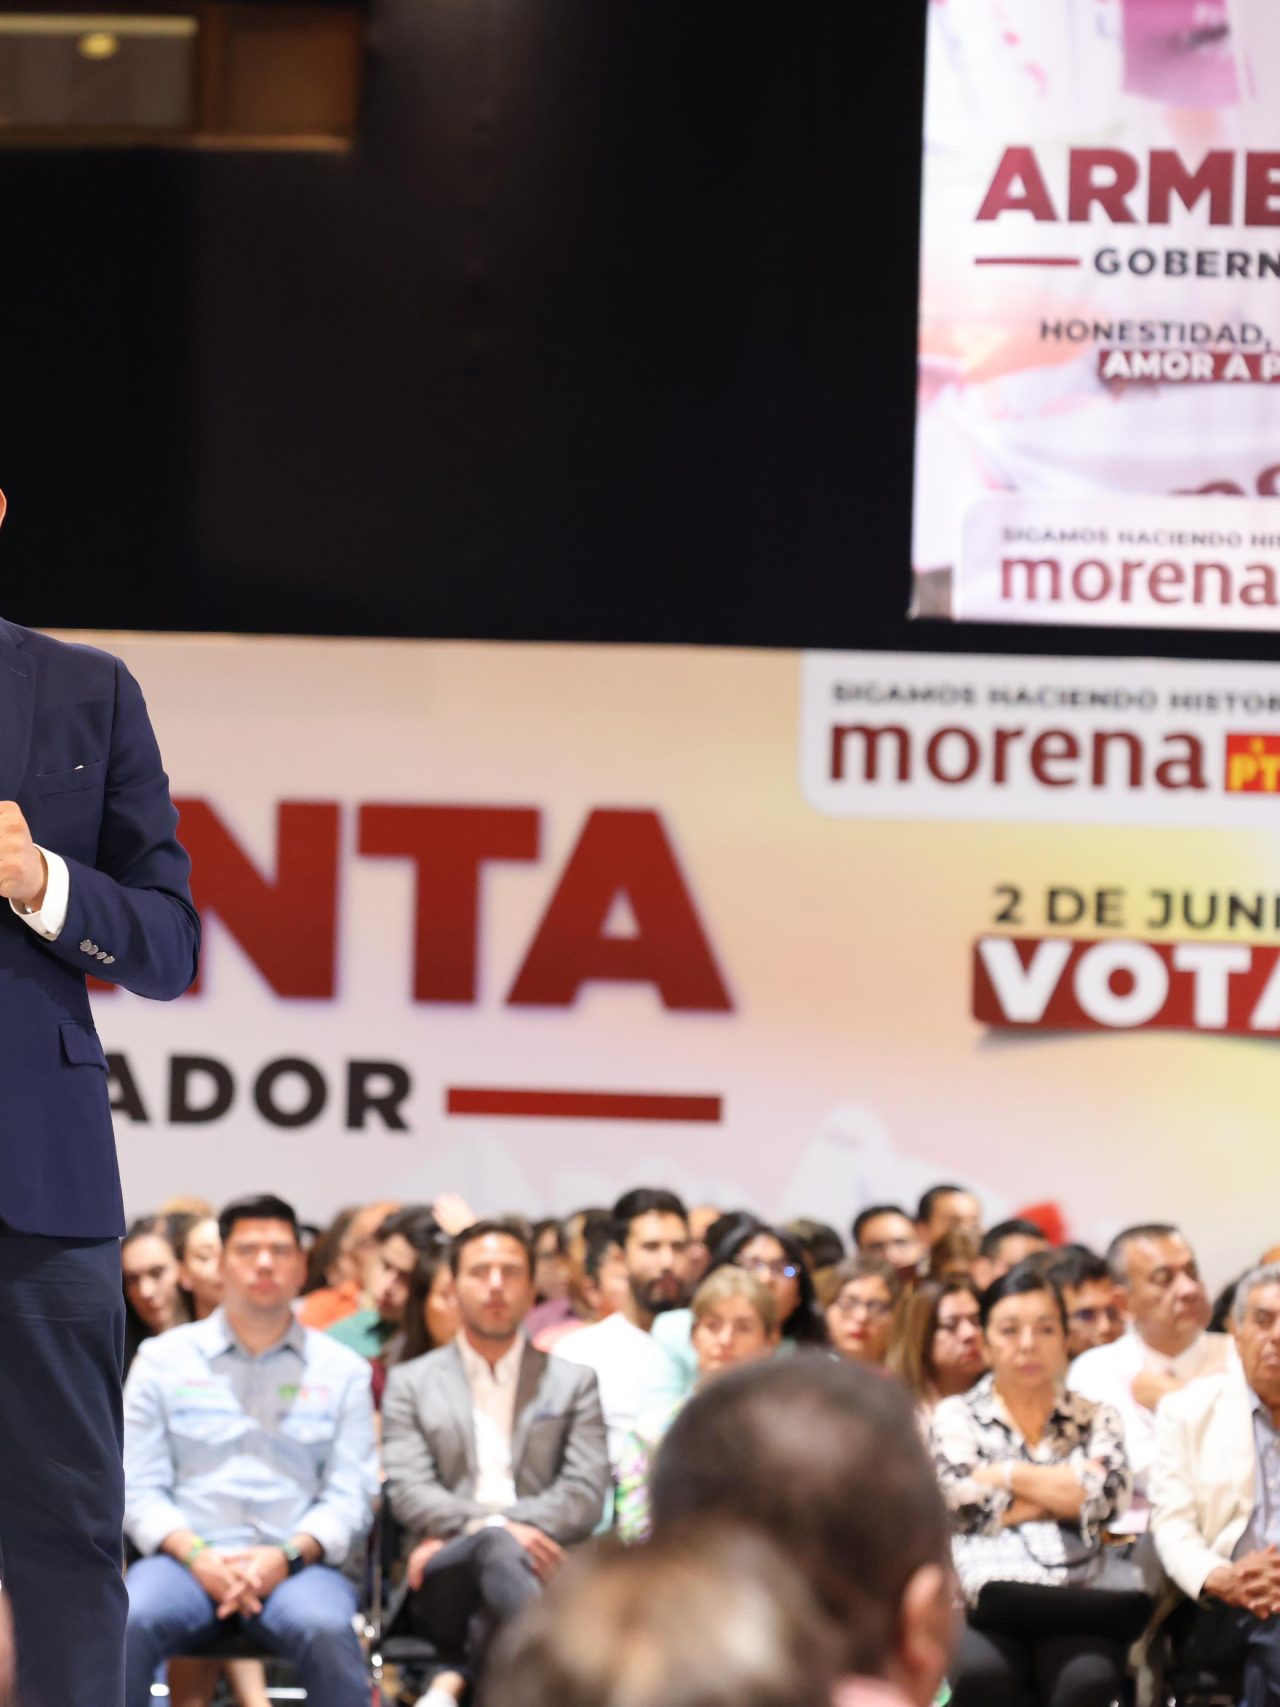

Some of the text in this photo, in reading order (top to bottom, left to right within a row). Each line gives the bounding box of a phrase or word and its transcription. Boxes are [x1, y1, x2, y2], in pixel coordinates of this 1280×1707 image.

[1040, 319, 1271, 352] HONESTIDAD,
[1103, 351, 1215, 381] AMOR
[1223, 353, 1252, 381] A
[1117, 529, 1242, 548] HACIENDO
[1001, 556, 1280, 608] morena
[832, 682, 977, 706] SIGAMOS
[987, 687, 1159, 712] HACIENDO
[828, 722, 1209, 792] morena
[993, 884, 1023, 926] 2
[1045, 886, 1126, 930] DE
